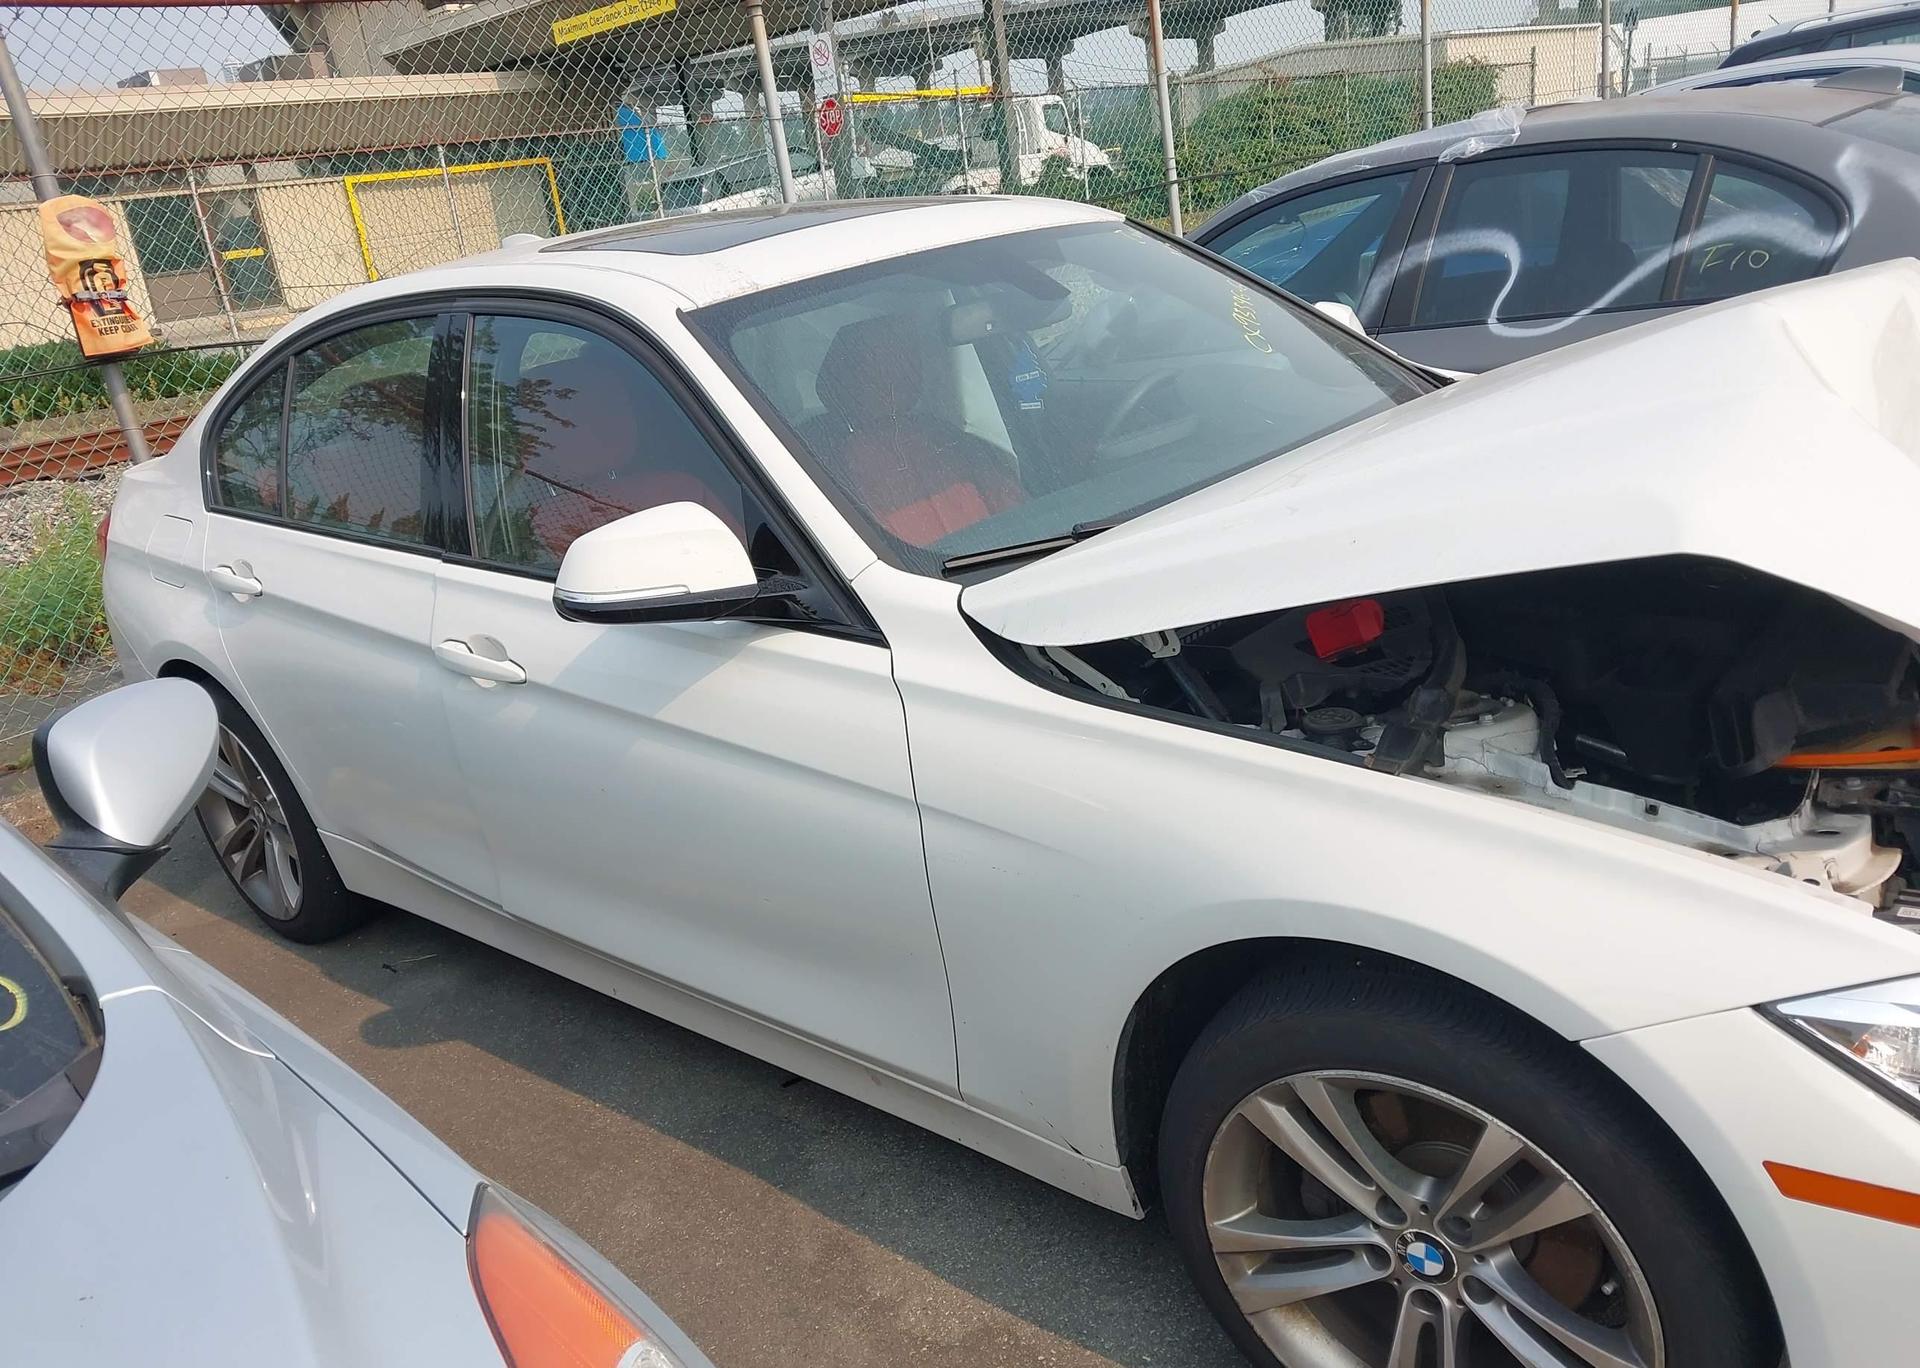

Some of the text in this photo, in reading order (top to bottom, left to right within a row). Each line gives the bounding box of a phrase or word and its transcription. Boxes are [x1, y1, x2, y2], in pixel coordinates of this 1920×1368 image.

[558, 22, 589, 33] Maximum
[589, 12, 623, 27] Clearance
[821, 110, 841, 126] STOP
[98, 326, 119, 336] KEEP
